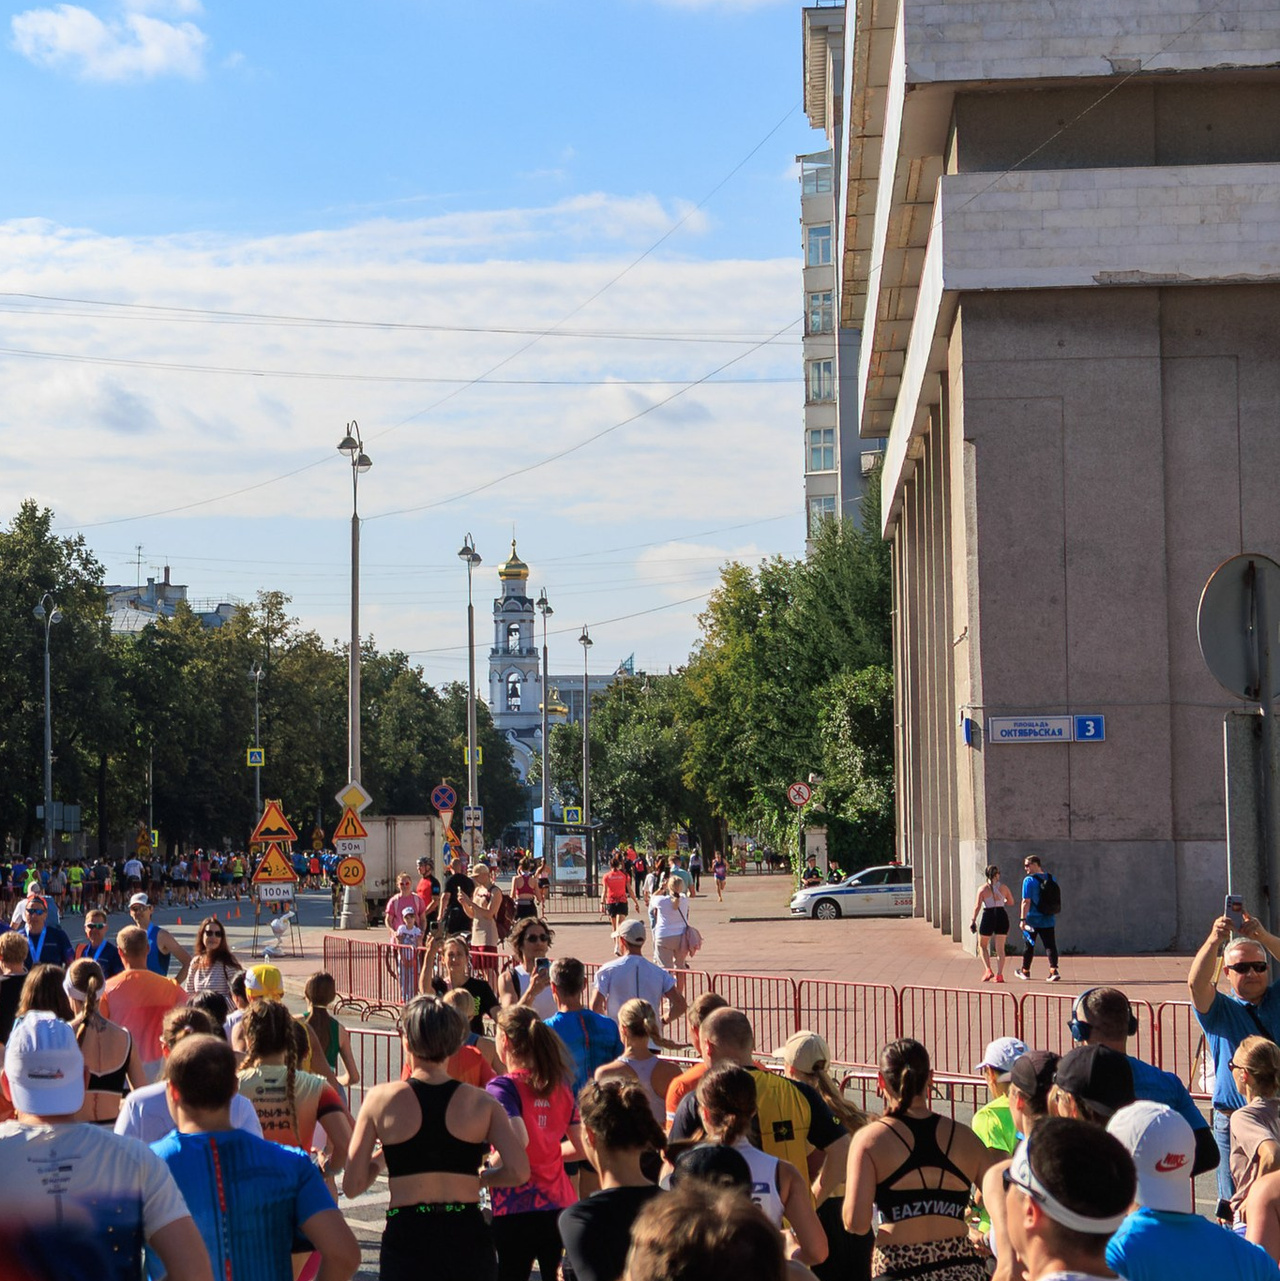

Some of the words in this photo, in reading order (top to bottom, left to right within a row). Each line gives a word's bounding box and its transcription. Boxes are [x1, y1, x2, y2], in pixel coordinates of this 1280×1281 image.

[1000, 728, 1063, 738] ОКТЯБРЬСКАЯ
[1085, 720, 1096, 736] 3
[343, 866, 360, 878] 20
[892, 1200, 964, 1221] EAZYWAY
